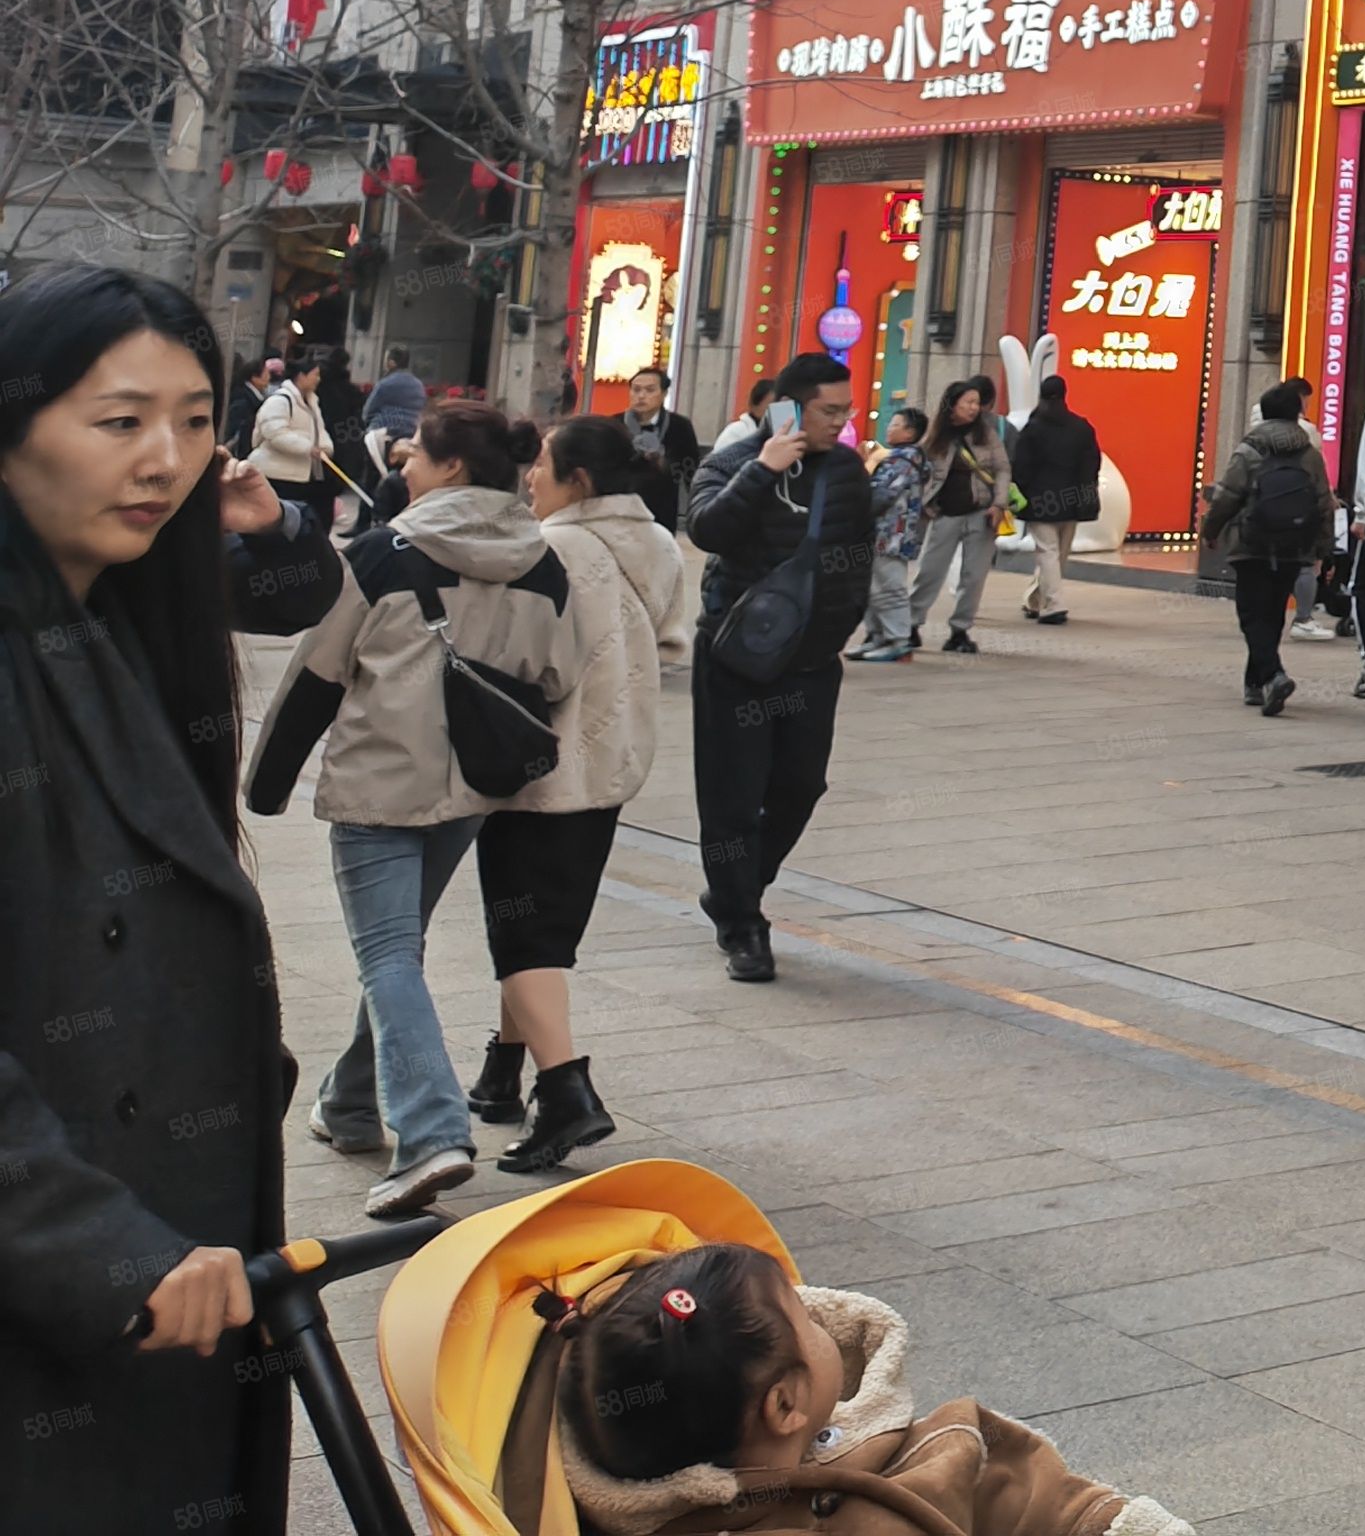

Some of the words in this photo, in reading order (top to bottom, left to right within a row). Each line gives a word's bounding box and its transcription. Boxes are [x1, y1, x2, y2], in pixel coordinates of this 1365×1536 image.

[1339, 157, 1355, 189] XIE
[1335, 193, 1353, 267] HUANG
[1062, 269, 1197, 318] 大白兔
[1330, 269, 1347, 327] TANG
[1327, 333, 1343, 376] BAO
[1321, 381, 1339, 443] GUAN
